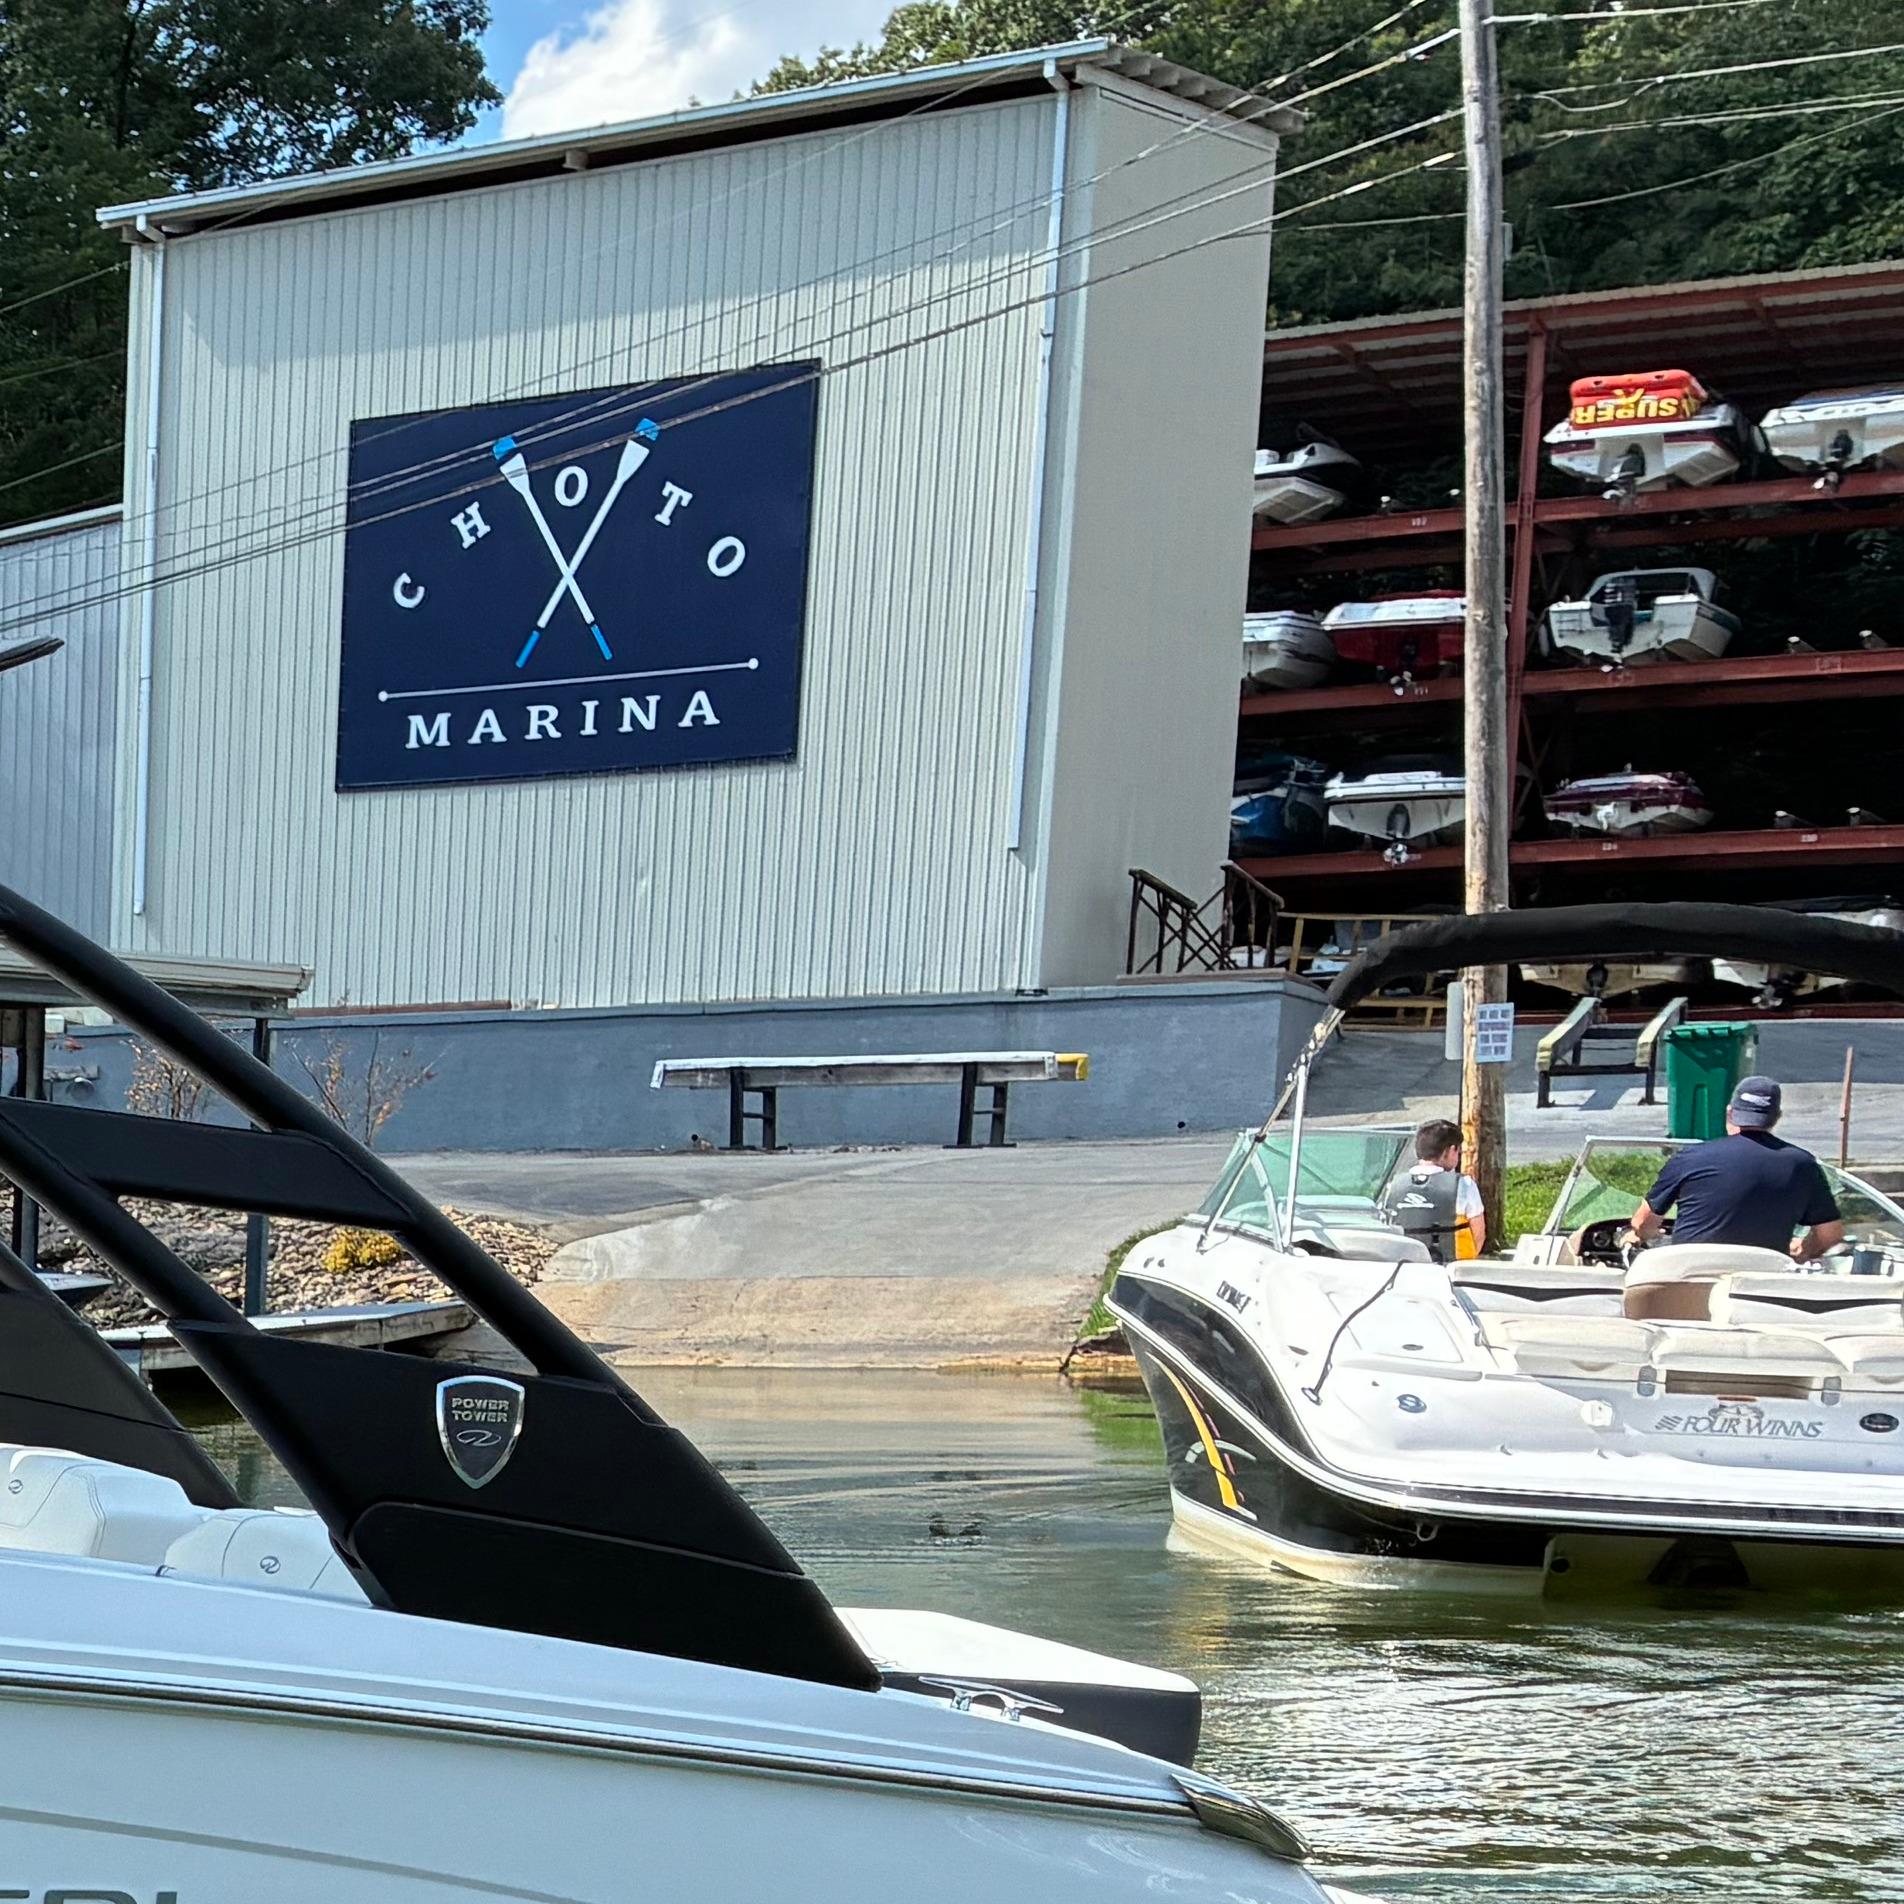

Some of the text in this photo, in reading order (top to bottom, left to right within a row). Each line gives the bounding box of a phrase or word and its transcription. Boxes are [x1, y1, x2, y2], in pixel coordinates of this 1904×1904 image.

[1575, 397, 1678, 424] SUPER
[392, 465, 746, 609] CHOTO
[405, 690, 720, 749] MARINA
[451, 1410, 509, 1423] TOWER
[452, 1397, 510, 1411] POWER
[1682, 1415, 1824, 1438] FOUR WINNS
